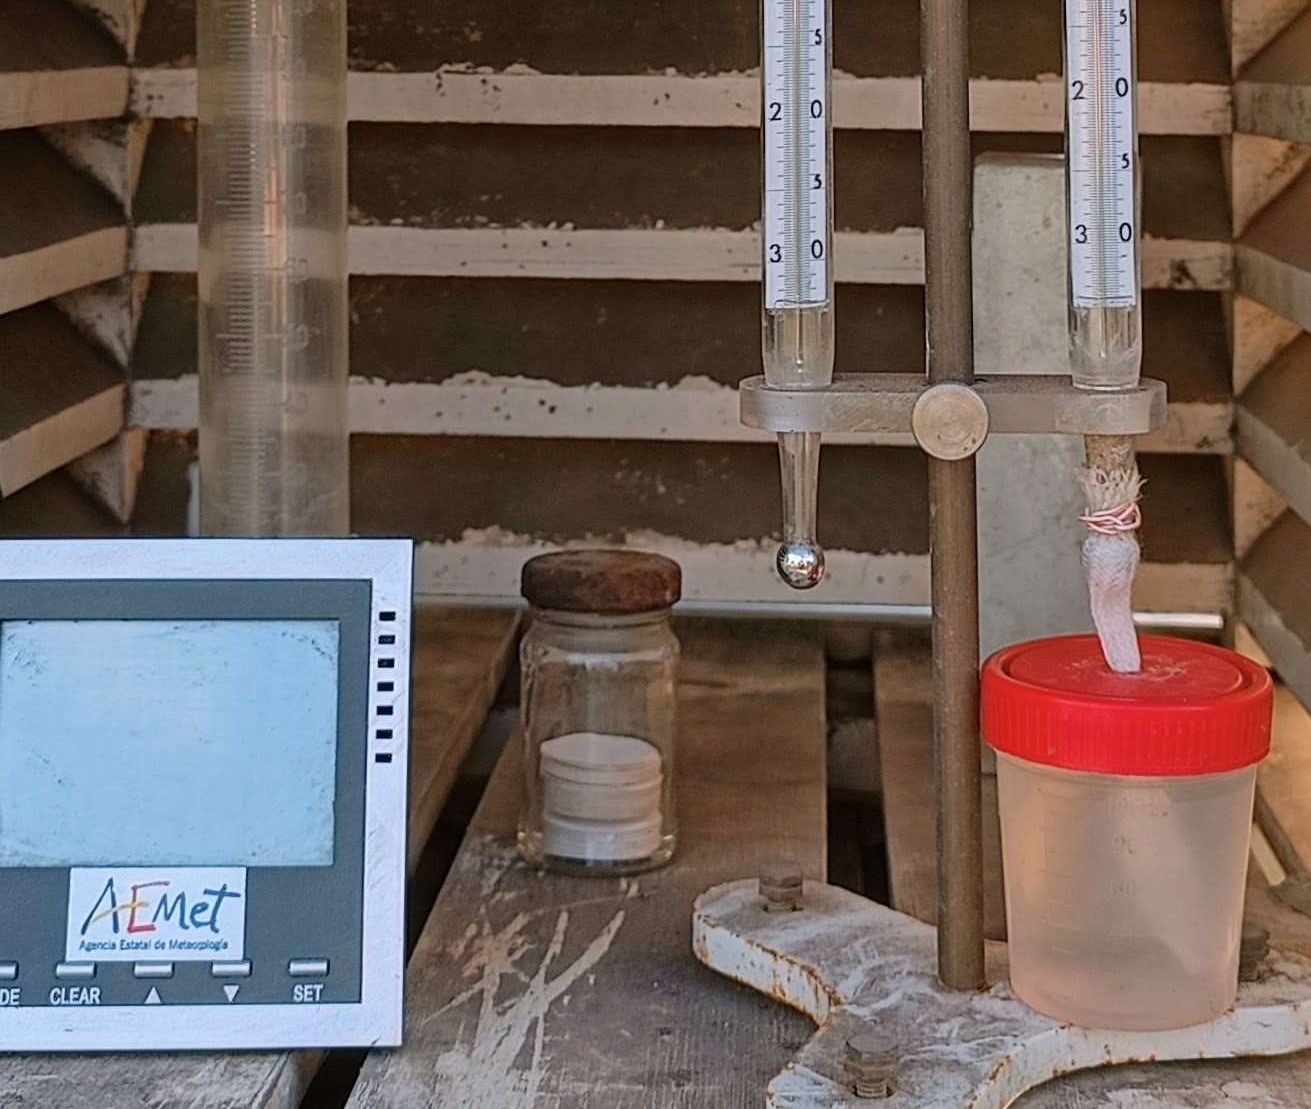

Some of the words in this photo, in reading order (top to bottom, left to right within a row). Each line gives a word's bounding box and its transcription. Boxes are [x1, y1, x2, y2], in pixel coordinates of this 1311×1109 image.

[79, 940, 117, 952] Agencia
[120, 940, 151, 950] Estatal
[154, 941, 166, 950] de
[49, 988, 101, 1004] CLEAR
[293, 984, 324, 1002] SET
